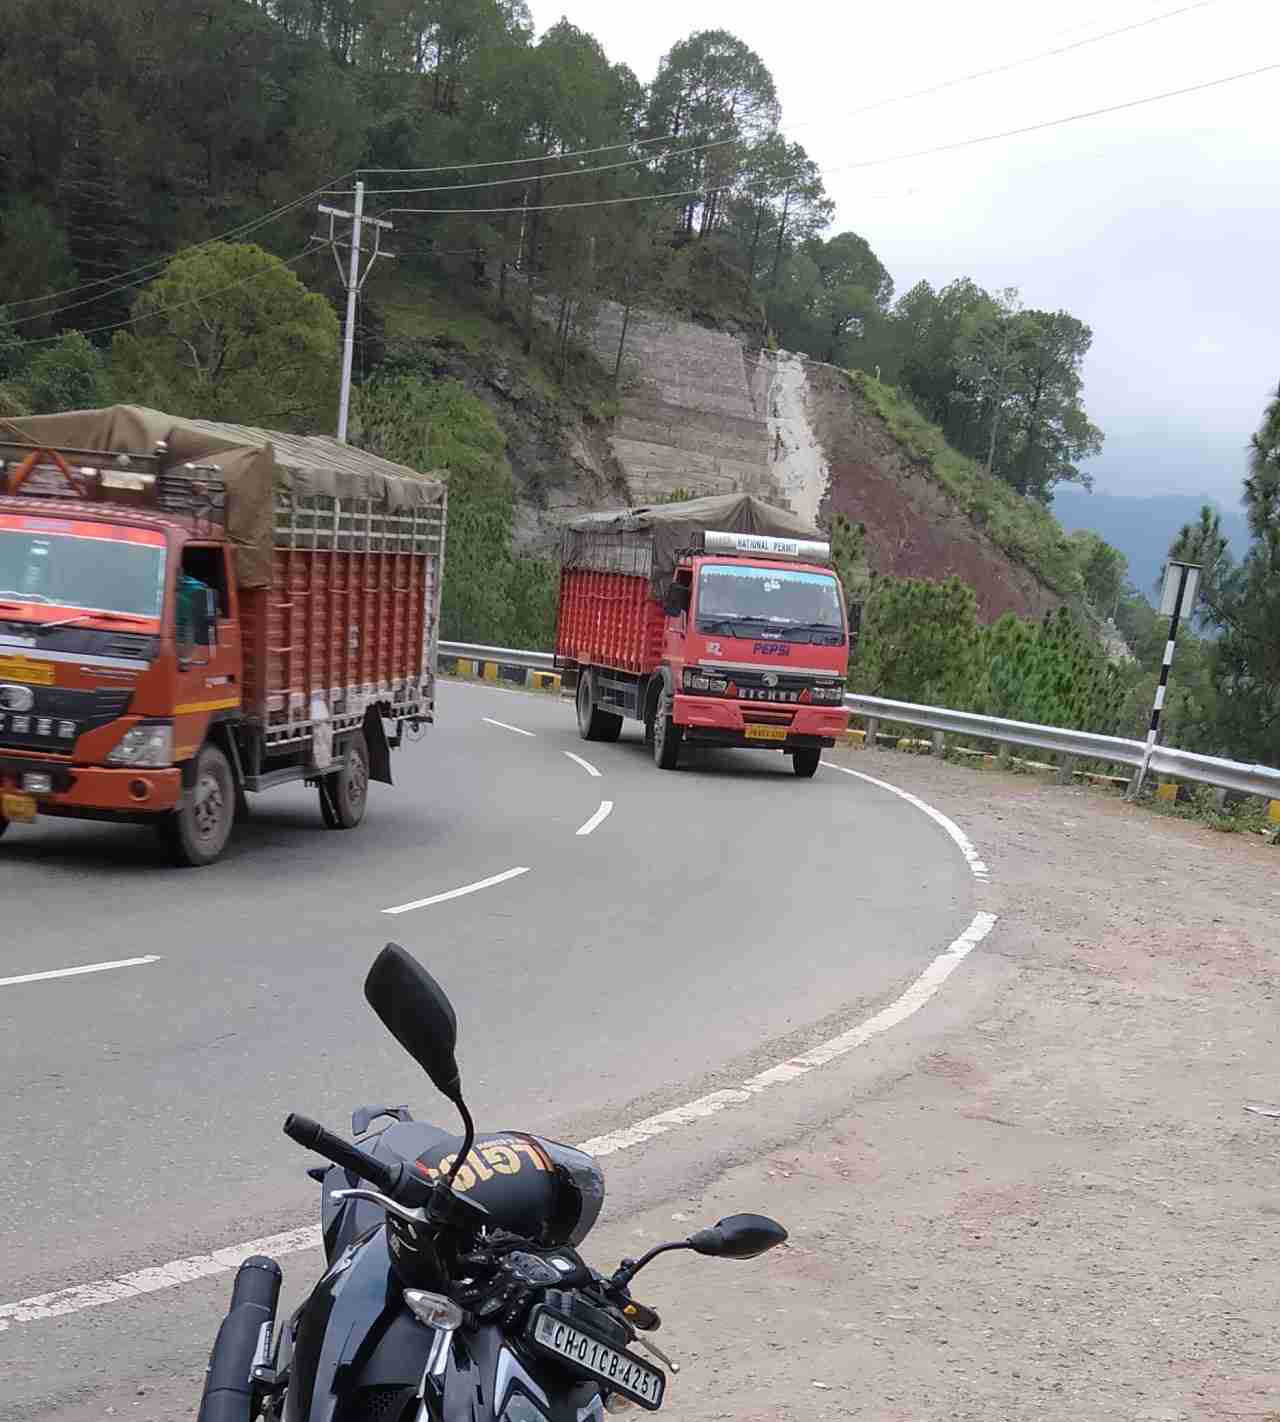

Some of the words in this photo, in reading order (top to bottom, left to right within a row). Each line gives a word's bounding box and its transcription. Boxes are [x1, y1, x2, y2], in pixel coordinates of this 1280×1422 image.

[737, 535, 769, 551] NATIONAL
[773, 541, 798, 553] PERMIT
[752, 642, 790, 656] PEPSI
[738, 688, 798, 701] EICHER
